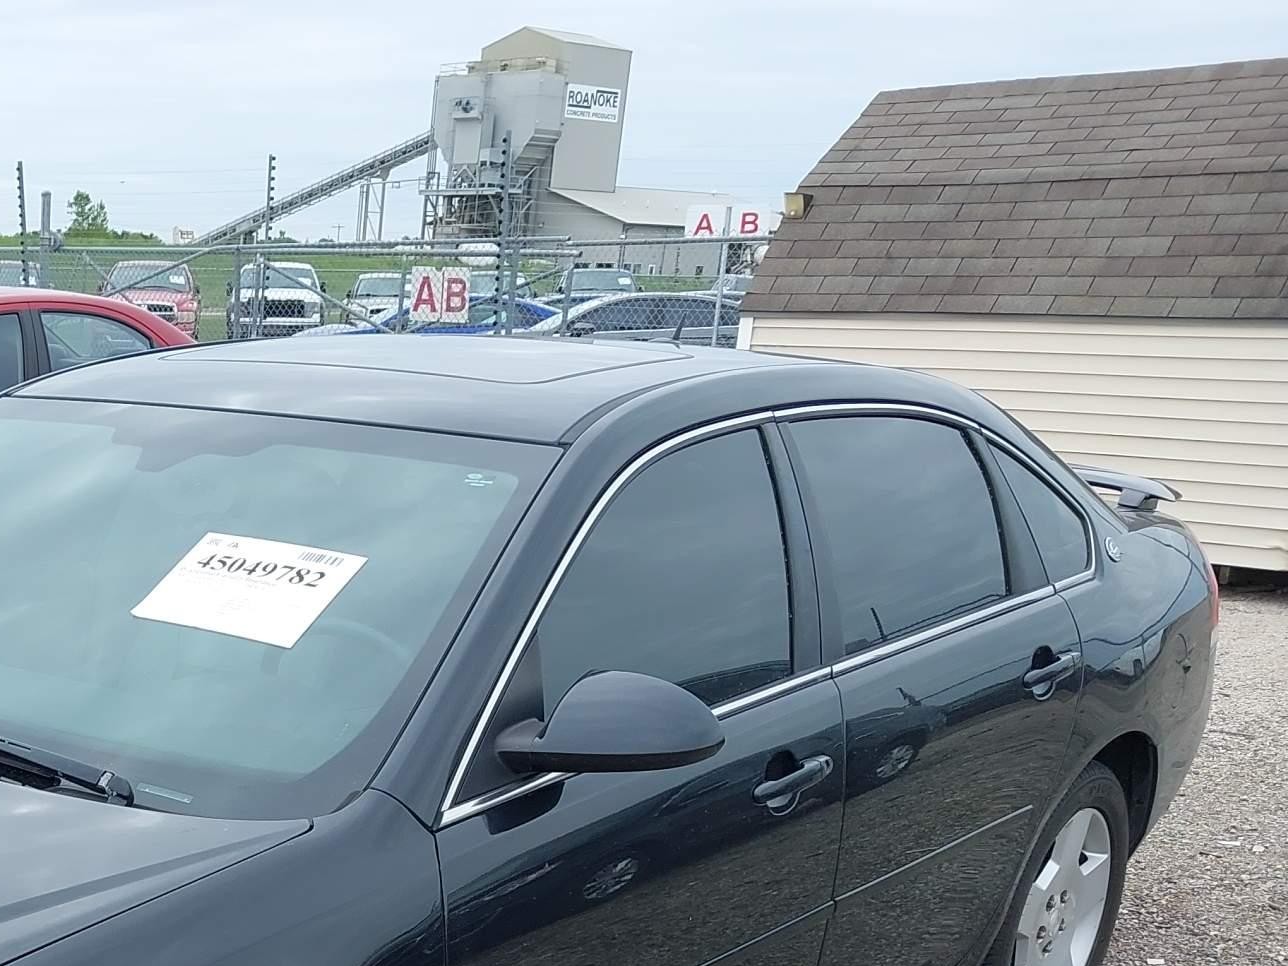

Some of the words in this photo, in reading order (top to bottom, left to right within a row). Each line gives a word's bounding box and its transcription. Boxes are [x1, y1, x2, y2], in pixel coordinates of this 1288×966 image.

[568, 90, 619, 108] ROANOKE
[693, 213, 714, 235] A
[740, 212, 759, 234] B
[197, 553, 326, 588] 45049782
